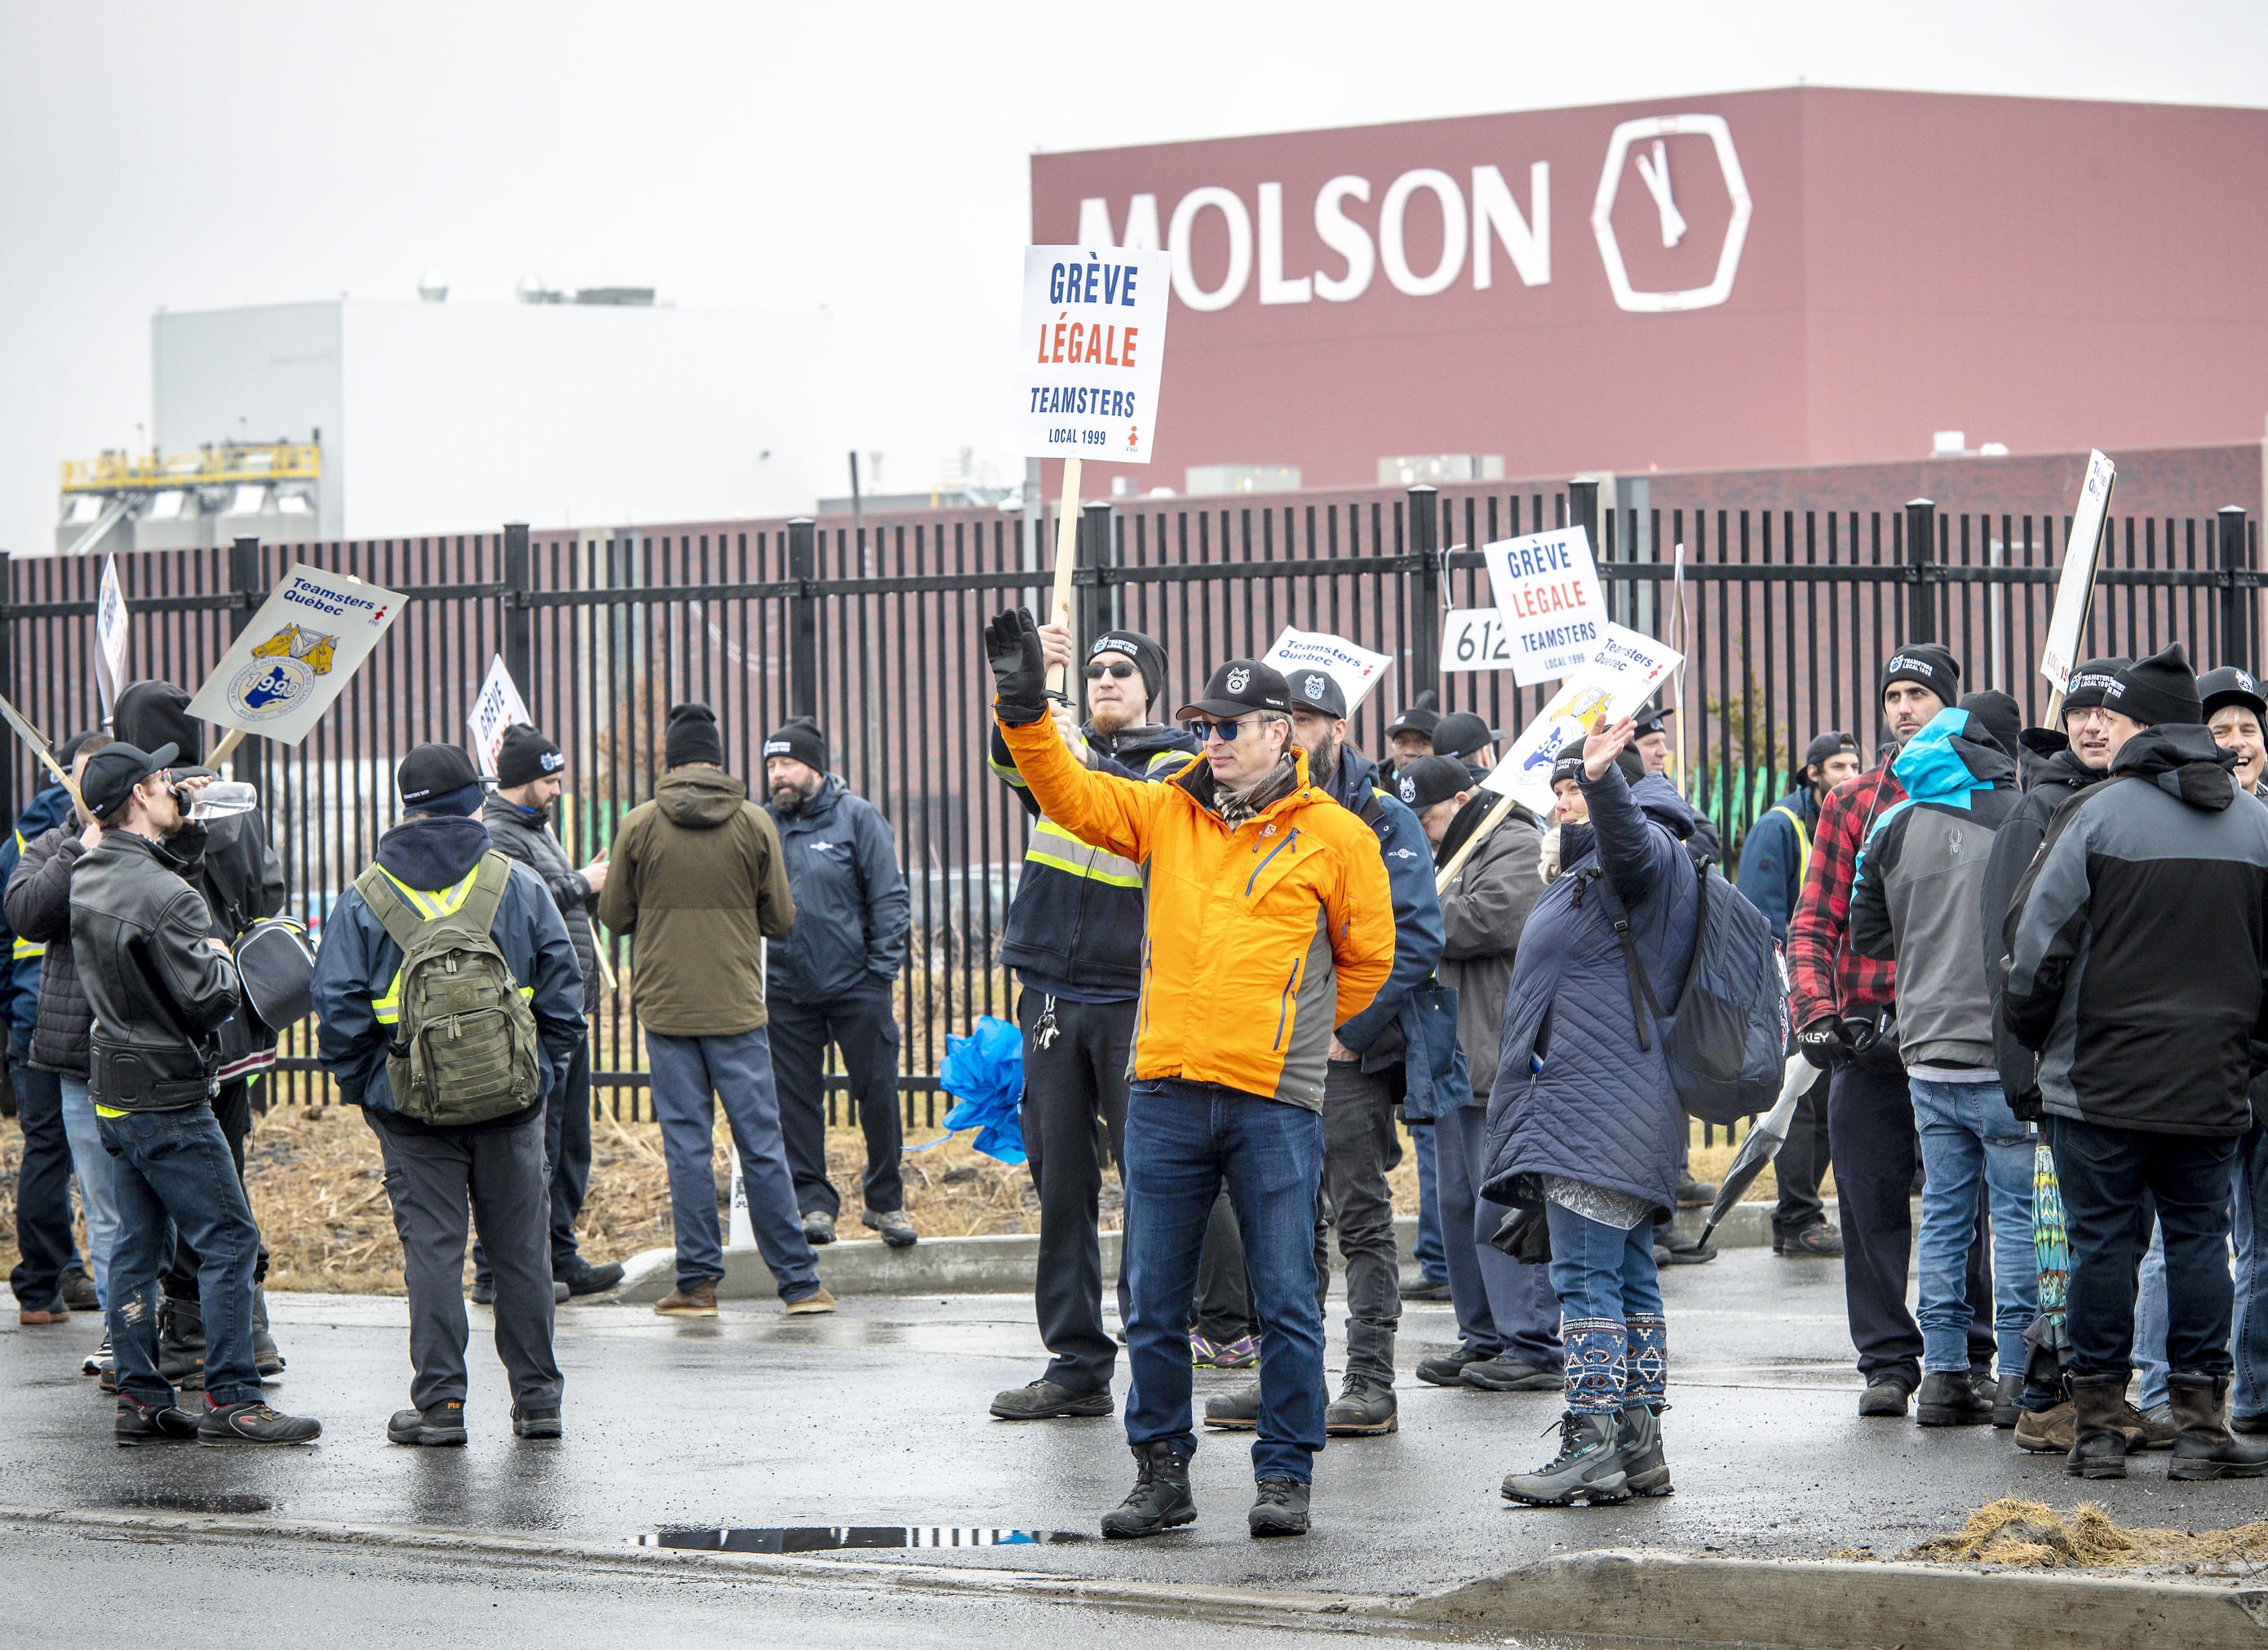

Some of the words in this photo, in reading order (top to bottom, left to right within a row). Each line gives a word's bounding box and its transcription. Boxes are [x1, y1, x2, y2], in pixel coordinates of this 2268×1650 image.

[1050, 251, 1138, 307] GRÈVE
[1037, 312, 1138, 367] LÉGALE
[1030, 387, 1136, 418] TEAMSTERS
[1048, 428, 1078, 443] LOCAL
[1082, 430, 1106, 446] 1999
[1507, 539, 1571, 579] GRÈVE
[283, 590, 344, 616] Québec
[293, 577, 374, 610] Teamsters
[1513, 580, 1587, 619] LÉGALE
[1521, 622, 1597, 653] TEAMSTERS
[1287, 640, 1362, 668] Teamsters
[1544, 657, 1566, 670] LOCAL
[1569, 653, 1585, 665] 1999
[1903, 658, 1933, 672] TEAMSTERS
[1903, 663, 1919, 672] LOCAL
[1919, 667, 1932, 676] 1999
[2061, 666, 2069, 682] 19
[246, 672, 301, 698] 1999
[2080, 680, 2097, 688] LOCAL
[2097, 681, 2110, 689] 199
[481, 680, 505, 740] GRÈVE
[1557, 757, 1584, 767] TEAMSTER
[1796, 1031, 1830, 1044] AKLEY
